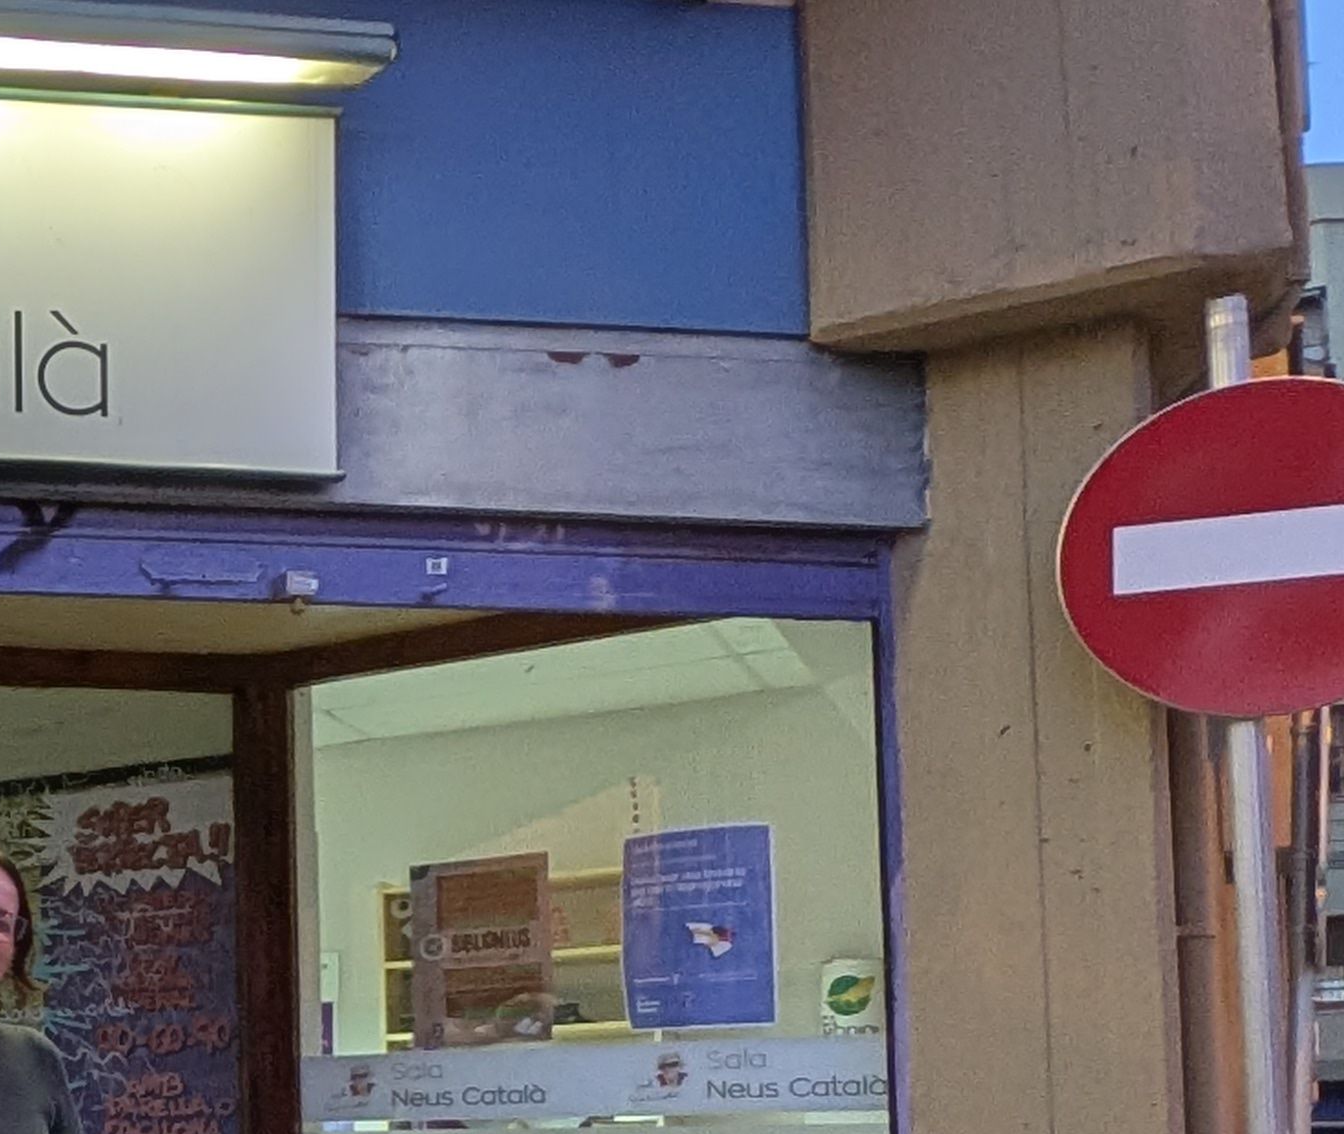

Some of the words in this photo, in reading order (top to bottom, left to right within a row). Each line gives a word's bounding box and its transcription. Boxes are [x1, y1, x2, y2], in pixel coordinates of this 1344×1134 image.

[706, 1049, 768, 1070] Sala
[391, 1062, 443, 1080] Sala
[391, 1089, 453, 1108] Neus
[462, 1084, 547, 1105] Català
[706, 1080, 779, 1100] Neus
[788, 1073, 887, 1097] Català
